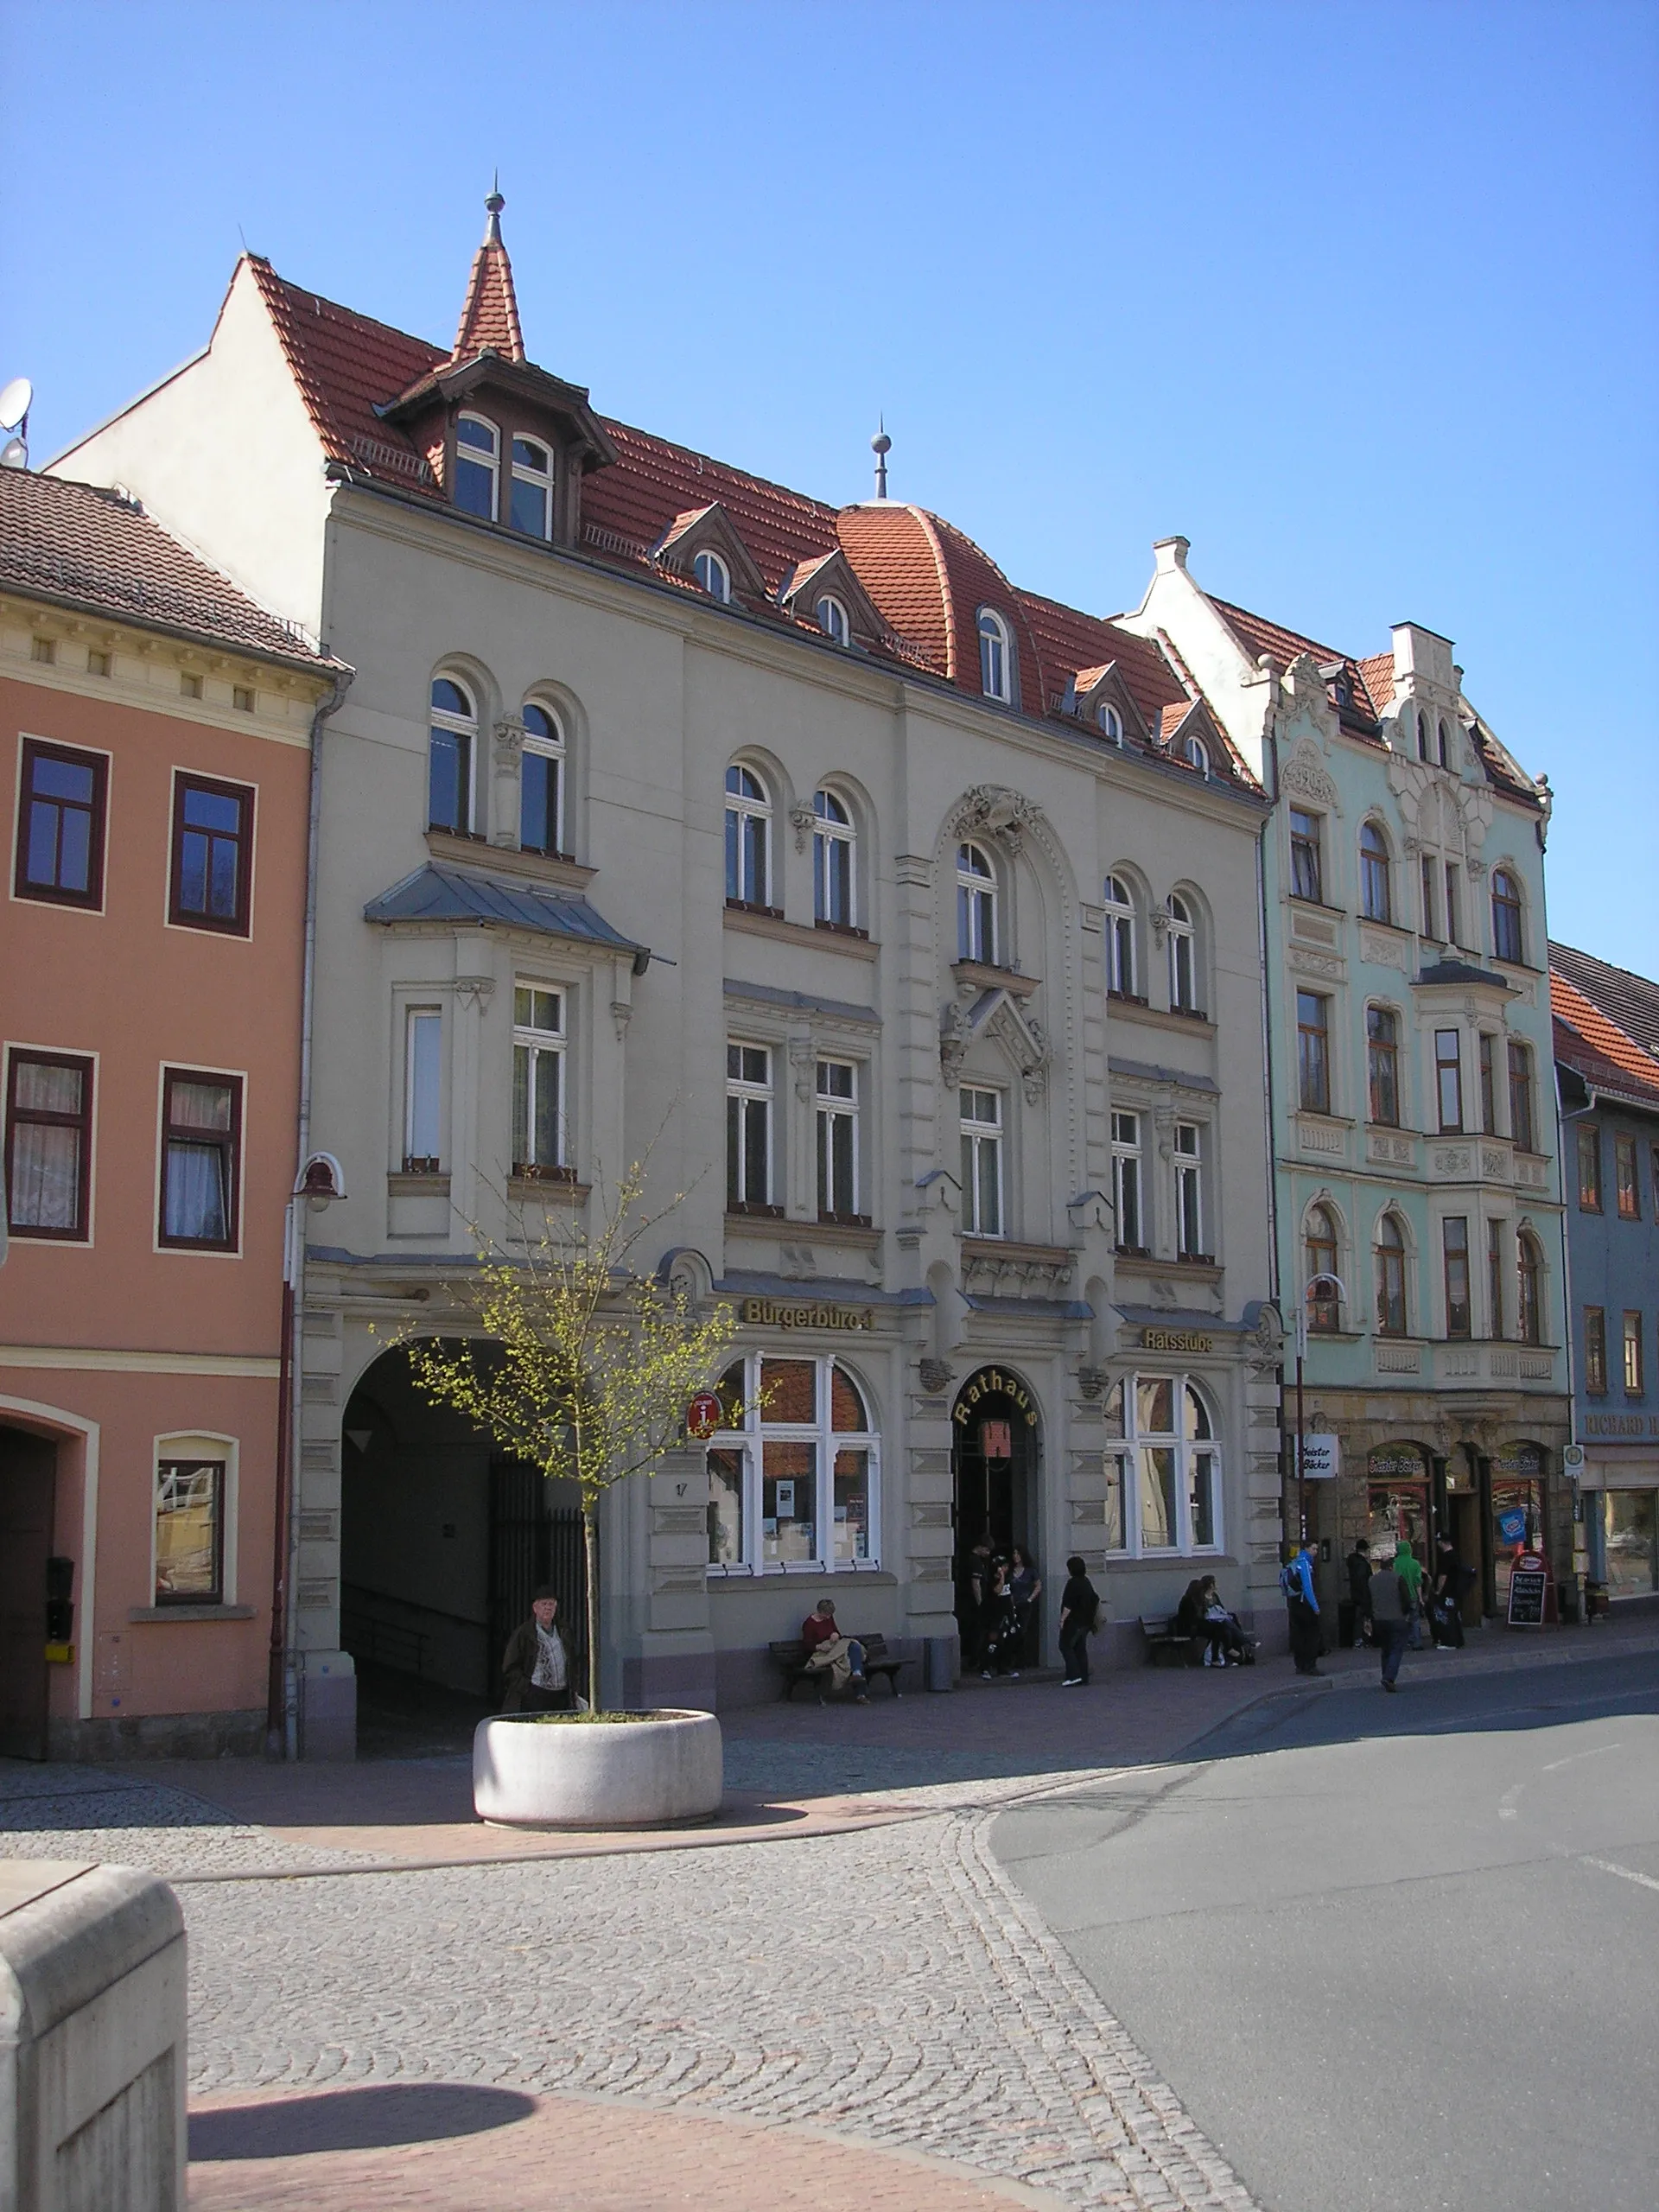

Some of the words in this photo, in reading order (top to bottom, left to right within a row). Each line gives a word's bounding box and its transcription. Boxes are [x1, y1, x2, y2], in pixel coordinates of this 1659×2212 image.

[1145, 1329, 1214, 1352] Ratsstube
[955, 1370, 1038, 1426] Rathaus
[1585, 1414, 1644, 1435] RICHARD
[676, 1483, 688, 1497] 17
